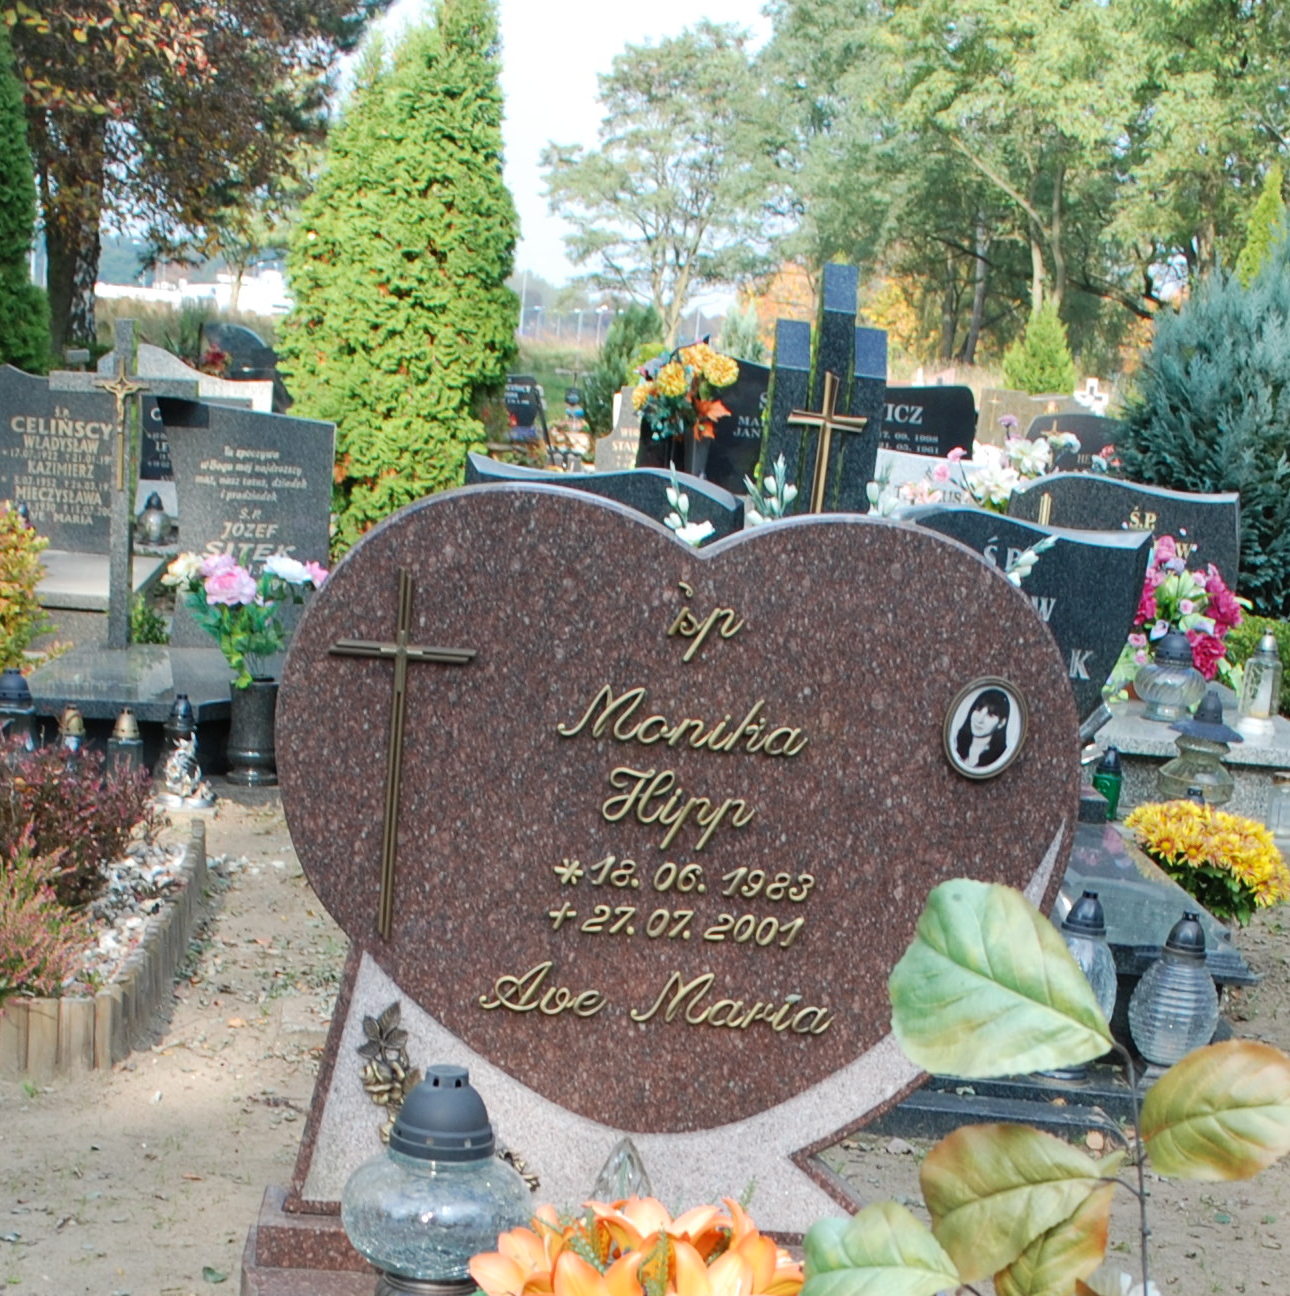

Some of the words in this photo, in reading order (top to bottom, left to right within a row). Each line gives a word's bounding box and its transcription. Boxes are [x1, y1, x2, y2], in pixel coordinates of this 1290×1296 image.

[11, 415, 113, 440] CELIŃSCY
[23, 434, 100, 455] WŁADYSŁAW
[27, 460, 94, 479] KAZIMIERZ
[15, 485, 102, 505] MIECZYSŁAWA
[220, 520, 278, 539] JÓZEF
[557, 684, 808, 756] Monika
[602, 766, 755, 850] Hipp
[478, 960, 606, 1017] Ave
[630, 971, 835, 1035] Maria
